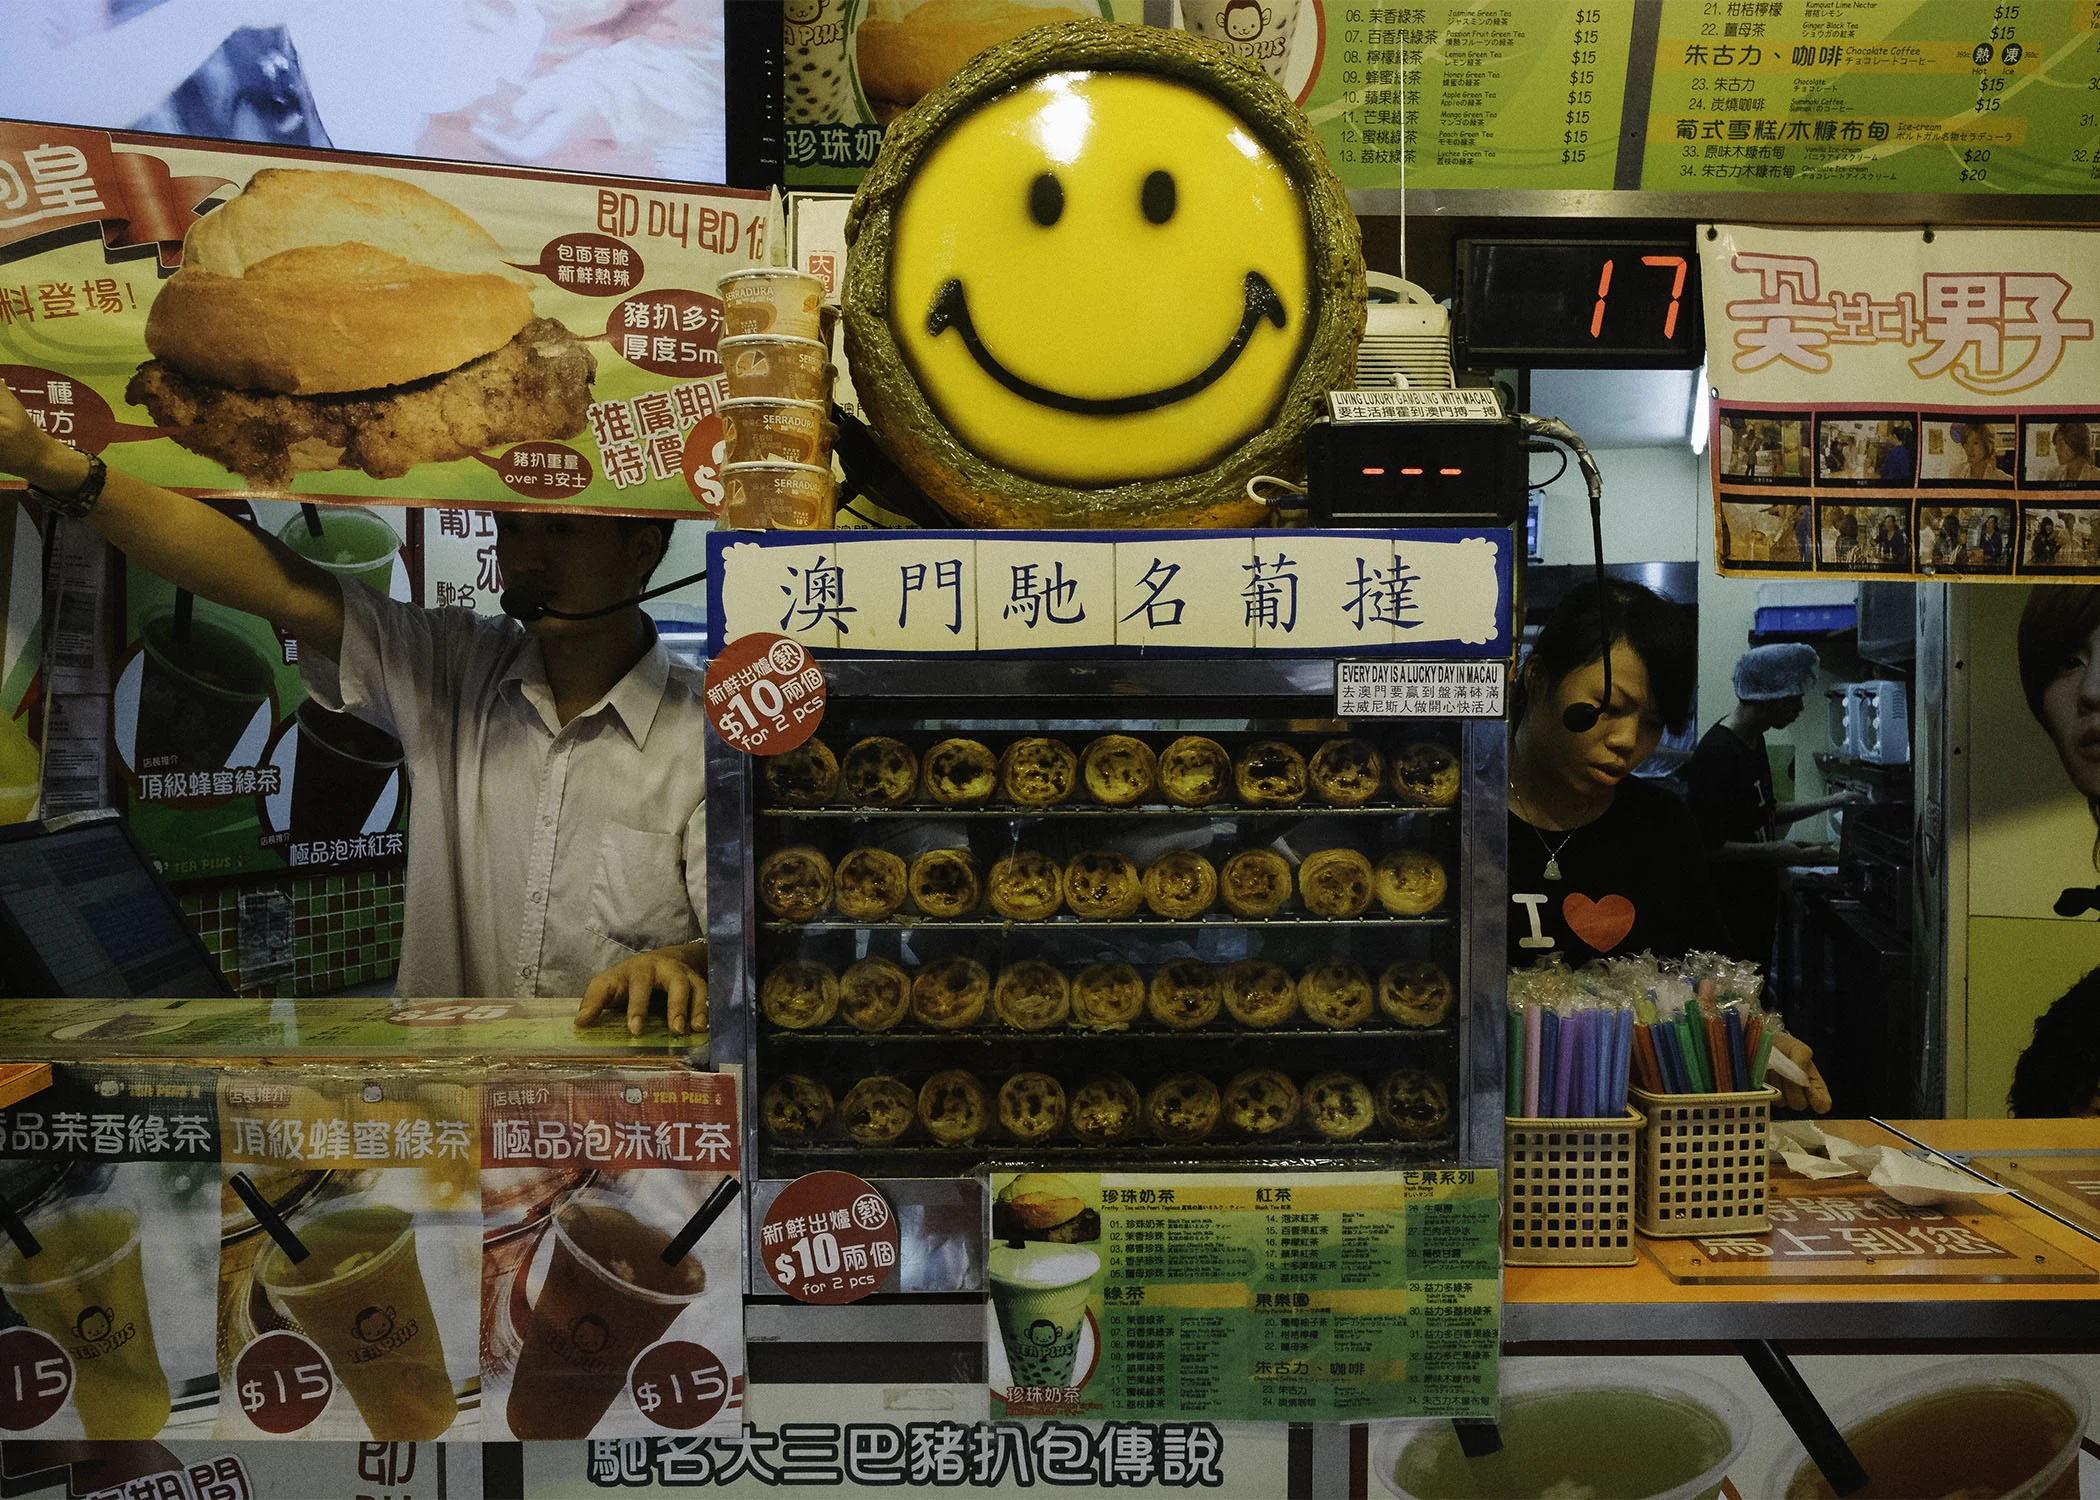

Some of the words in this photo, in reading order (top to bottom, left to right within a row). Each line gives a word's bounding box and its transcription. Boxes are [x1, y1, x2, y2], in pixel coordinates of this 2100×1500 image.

[1346, 10, 1364, 22] 06.
[1704, 3, 1721, 15] 21.
[1994, 5, 2020, 20] $15
[1576, 10, 1600, 24] $15
[1345, 31, 1362, 43] 07.
[1701, 24, 1718, 36] 22.
[1990, 26, 2015, 41] $15
[1574, 30, 1598, 45] $15
[1572, 50, 1596, 64] $15
[1846, 46, 1888, 55] Chocolate
[1890, 46, 1920, 55] Coffee
[2004, 48, 2018, 62] 凍
[1344, 52, 1361, 64] 08.
[1343, 71, 1360, 84] 09.
[1570, 71, 1594, 85] $15
[1691, 79, 1708, 90] 23.
[1714, 78, 1755, 92] 朱古力
[1979, 78, 2004, 92] $15
[1342, 91, 1360, 104] 10.
[1568, 92, 1592, 104] $15
[1689, 98, 1705, 110] 24.
[1975, 98, 2000, 112] $15
[1342, 112, 1358, 123] 11.
[1566, 112, 1590, 124] $15
[2080, 114, 2098, 126] 31.
[1676, 119, 1889, 141] 葡式雪糕/木糠布甸
[1898, 123, 1941, 131] Ice-cream
[1340, 131, 1357, 143] 12.
[1564, 132, 1588, 144] $15
[1340, 151, 1356, 162] 13.
[1562, 151, 1585, 164] $15
[1682, 146, 1699, 158] 33.
[1964, 150, 1990, 163] $20
[2072, 150, 2089, 162] 32.
[1680, 166, 1696, 176] 34.
[1702, 164, 1795, 179] 朱古力木糠布甸
[1960, 169, 1986, 182] $20
[557, 244, 629, 267] 包面香脆
[558, 265, 630, 287] 新鮮熱辣
[726, 286, 774, 302] SERRADURA
[1590, 255, 1688, 340] 17
[623, 334, 722, 366] 厚度5m
[8, 381, 73, 404] 一種
[1335, 393, 1362, 404] LIVING
[1362, 393, 1395, 404] LUXURY
[1396, 393, 1437, 404] GAMBLING
[1440, 393, 1462, 404] WITH
[1461, 393, 1492, 404] MACAU
[514, 452, 578, 469] 豬扒重量
[505, 473, 537, 484] over
[544, 472, 586, 488] 3安士
[779, 554, 1424, 634] 澳門馳名葡撻
[706, 656, 773, 706] 新鮮出爐
[771, 642, 802, 673] 熱
[1343, 666, 1370, 683] EVERY
[1372, 666, 1389, 683] DAY
[1391, 666, 1398, 683] IS
[1400, 666, 1406, 683] A
[1408, 666, 1437, 683] LUCKY
[1439, 666, 1455, 683] DAY
[1457, 666, 1465, 683] IN
[1467, 666, 1498, 683] MACAU
[719, 679, 784, 740] $10
[780, 668, 823, 704] 兩個
[1342, 700, 1498, 713] 去威尼斯人做開心快活人
[741, 728, 768, 750] for
[772, 714, 790, 732] 2
[792, 696, 824, 723] pcs
[139, 769, 278, 800] 頂級蜂蜜綠茶
[290, 834, 402, 866] 極品泡沫紅茶
[1512, 893, 1555, 948] I
[494, 1088, 549, 1106] 店長推介
[230, 1117, 470, 1160] 頂級蜂蜜綠茶
[493, 1120, 731, 1163] 極品泡沫紅茶
[1102, 1190, 1174, 1204] 珍珠奶茶
[1256, 1188, 1291, 1202] 紅茶
[762, 1209, 852, 1245] 新鮮出爐
[855, 1196, 886, 1228] 熱
[775, 1232, 840, 1285] $10
[841, 1241, 895, 1272] 兩個
[802, 1283, 826, 1295] for
[832, 1277, 843, 1289] 2
[850, 1275, 875, 1288] pcs
[14, 1358, 68, 1401] 15
[242, 1364, 329, 1413] $15
[637, 1365, 725, 1413] $15
[1007, 1386, 1080, 1403] 珍珠奶茶
[590, 1424, 1221, 1484] 馳名大三巴豬扒包傳說
